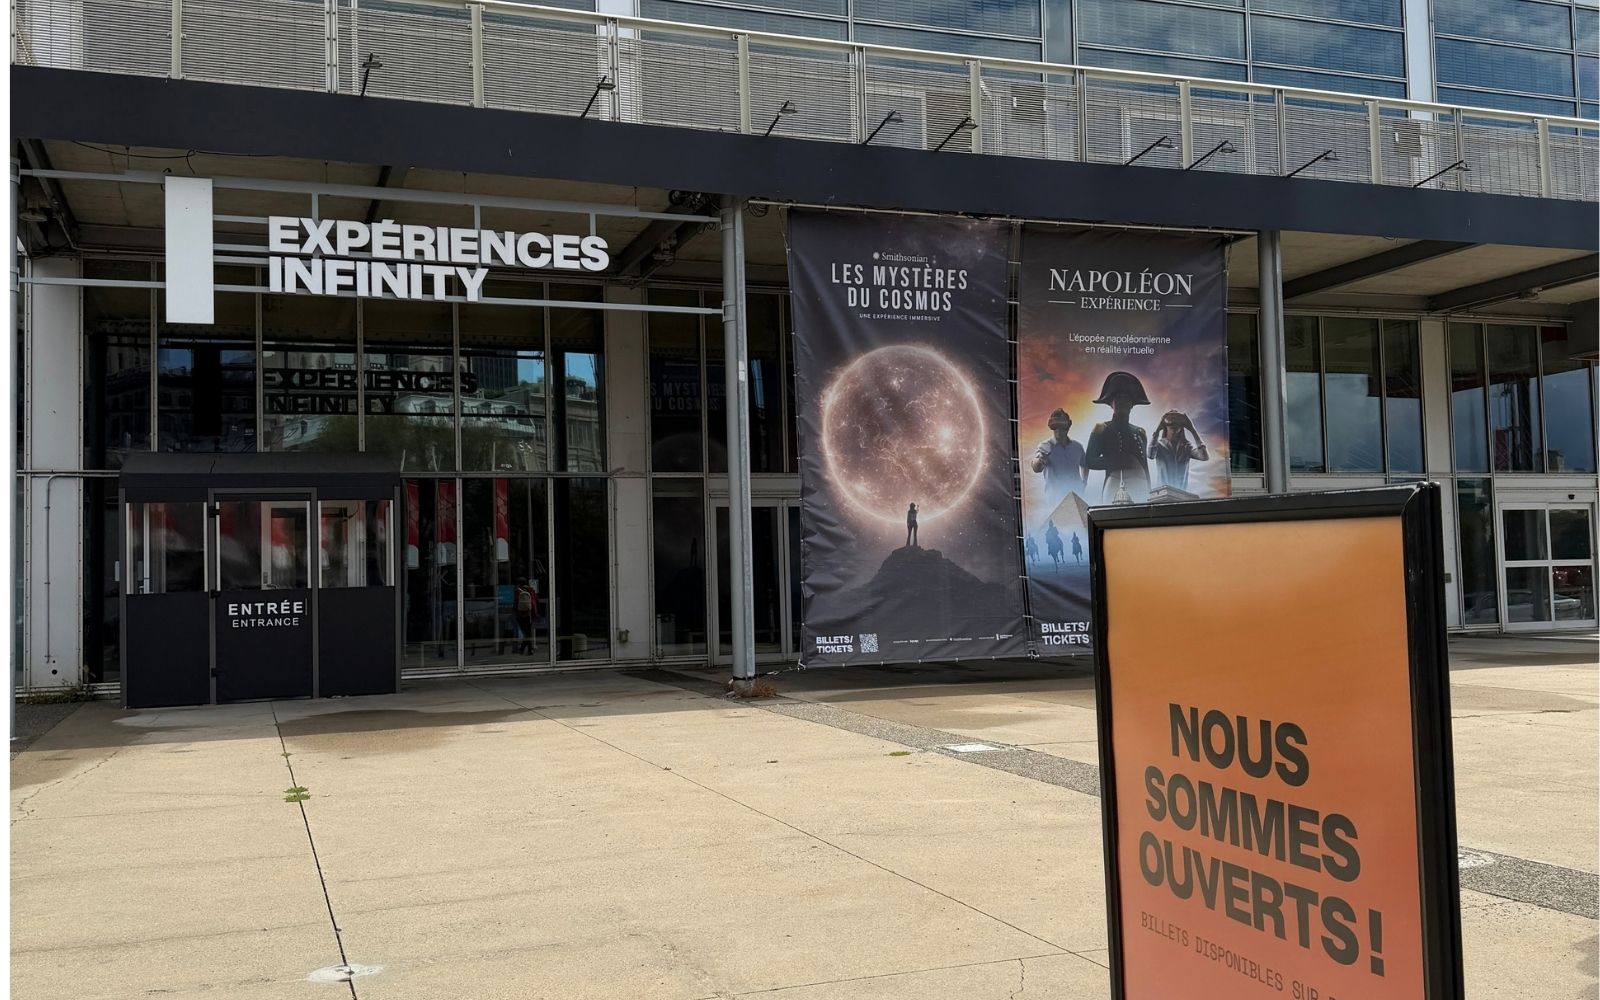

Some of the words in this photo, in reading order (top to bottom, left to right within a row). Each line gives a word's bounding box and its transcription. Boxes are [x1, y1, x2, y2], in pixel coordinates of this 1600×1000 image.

[269, 216, 610, 271] EXPÉRIENCES
[881, 252, 928, 263] Smithsonian
[269, 256, 489, 302] INFINITY
[831, 263, 863, 285] LES
[873, 264, 968, 290] MYSTÈRES
[1048, 268, 1194, 296] NAPOLÉON
[848, 287, 870, 308] DU
[880, 288, 952, 311] COSMOS
[1081, 295, 1161, 311] EXPÉRIENCE
[872, 313, 908, 321] EXPÉRIENCE
[1069, 333, 1105, 344] L'épopée
[1106, 334, 1171, 345] napoléonnienne
[1085, 346, 1096, 354] en
[1097, 345, 1121, 354] réalité
[1122, 346, 1155, 355] virtuelle
[228, 599, 303, 616] ENTRÉE
[232, 617, 299, 628] ENTRANCE
[1041, 622, 1090, 633] BILLETS/
[816, 635, 854, 644] BILLETS/
[1042, 634, 1090, 645] TICKETS
[817, 645, 854, 653] TICKETS
[1169, 703, 1310, 787] NOUS
[1144, 765, 1361, 882] SOMMES
[1141, 911, 1189, 947] BILLETS
[1196, 936, 1283, 992] DISPONIBLES
[1292, 981, 1319, 1000] SUR
